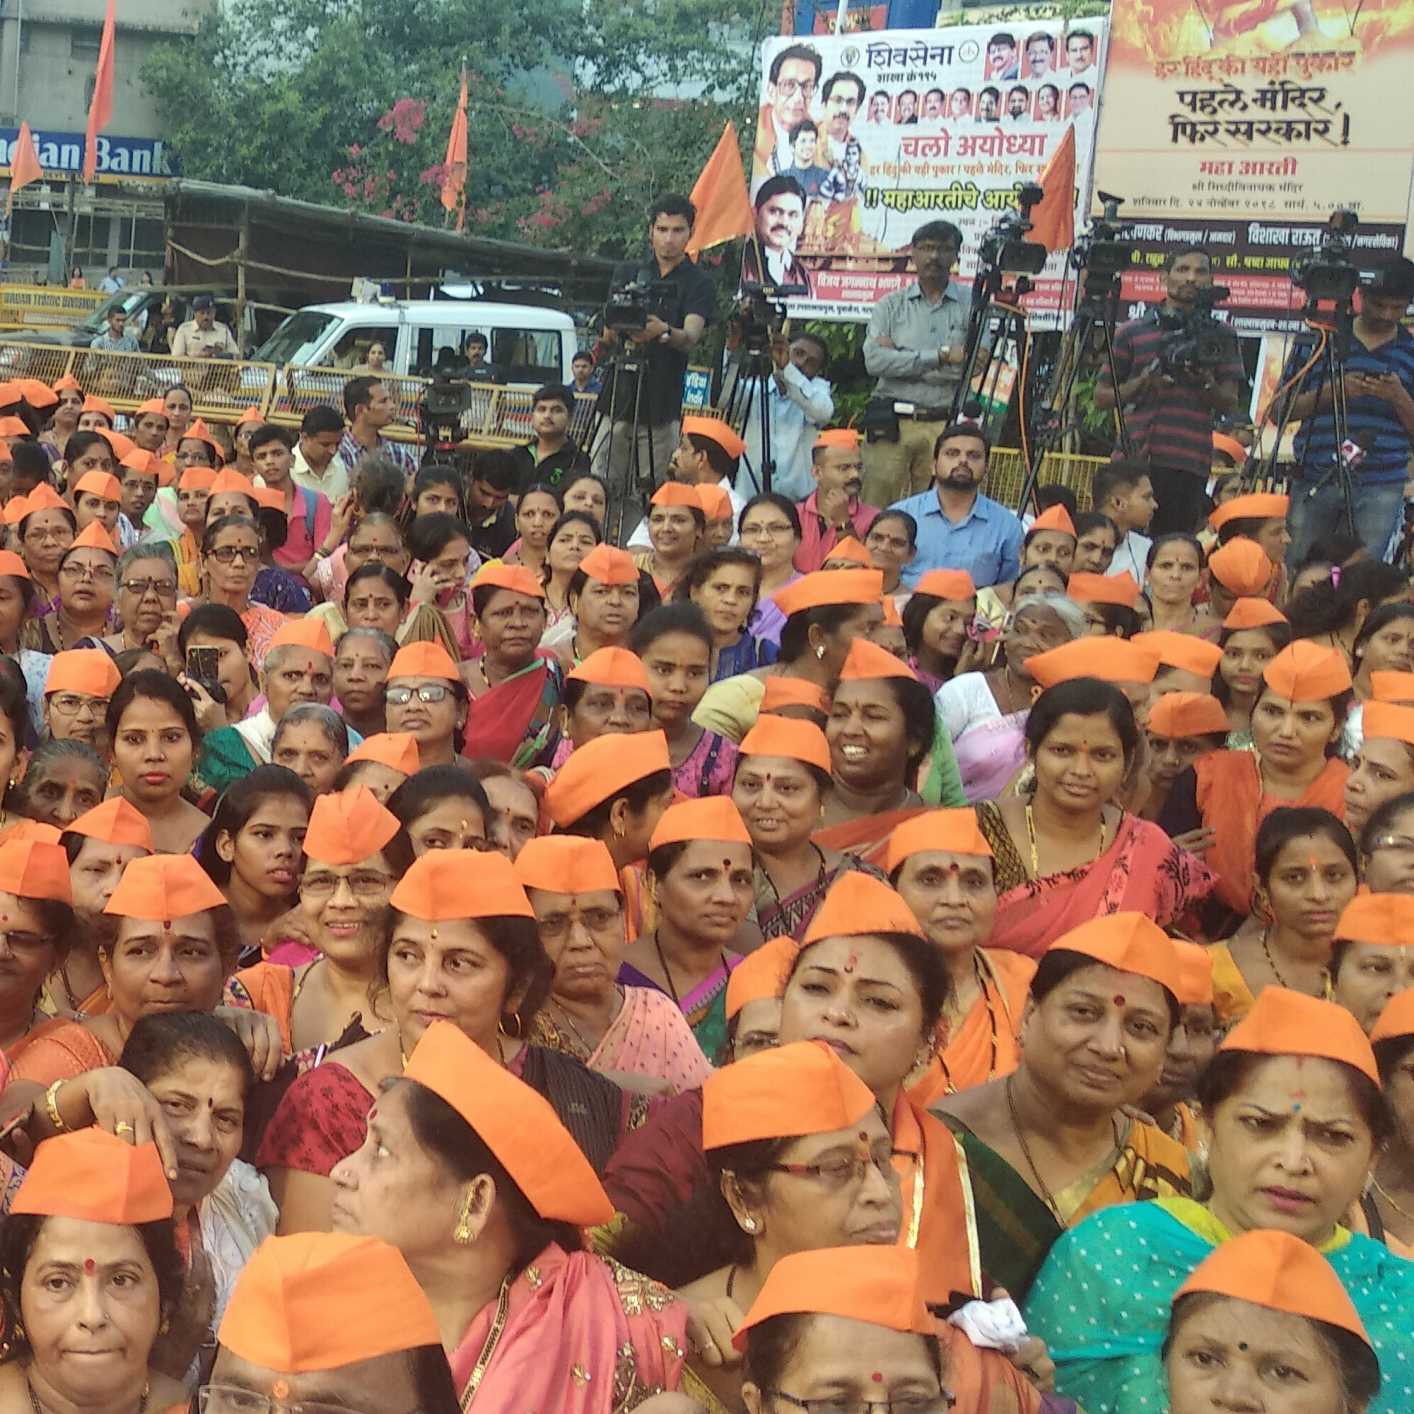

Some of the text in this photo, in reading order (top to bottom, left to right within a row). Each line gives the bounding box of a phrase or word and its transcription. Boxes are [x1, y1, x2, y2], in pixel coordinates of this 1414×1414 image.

[866, 40, 955, 69] शिवसेना
[1219, 54, 1246, 76] की
[1251, 52, 1287, 80] यही
[1291, 51, 1356, 80] पुकार
[1177, 80, 1342, 118] पहले मंदिर,
[902, 126, 1048, 157] चलो अयोध्या
[1169, 114, 1224, 145] फिर
[1199, 156, 1298, 176] महा आरती
[881, 181, 980, 212] महाआरतीचे
[1248, 222, 1290, 245] विशाखा
